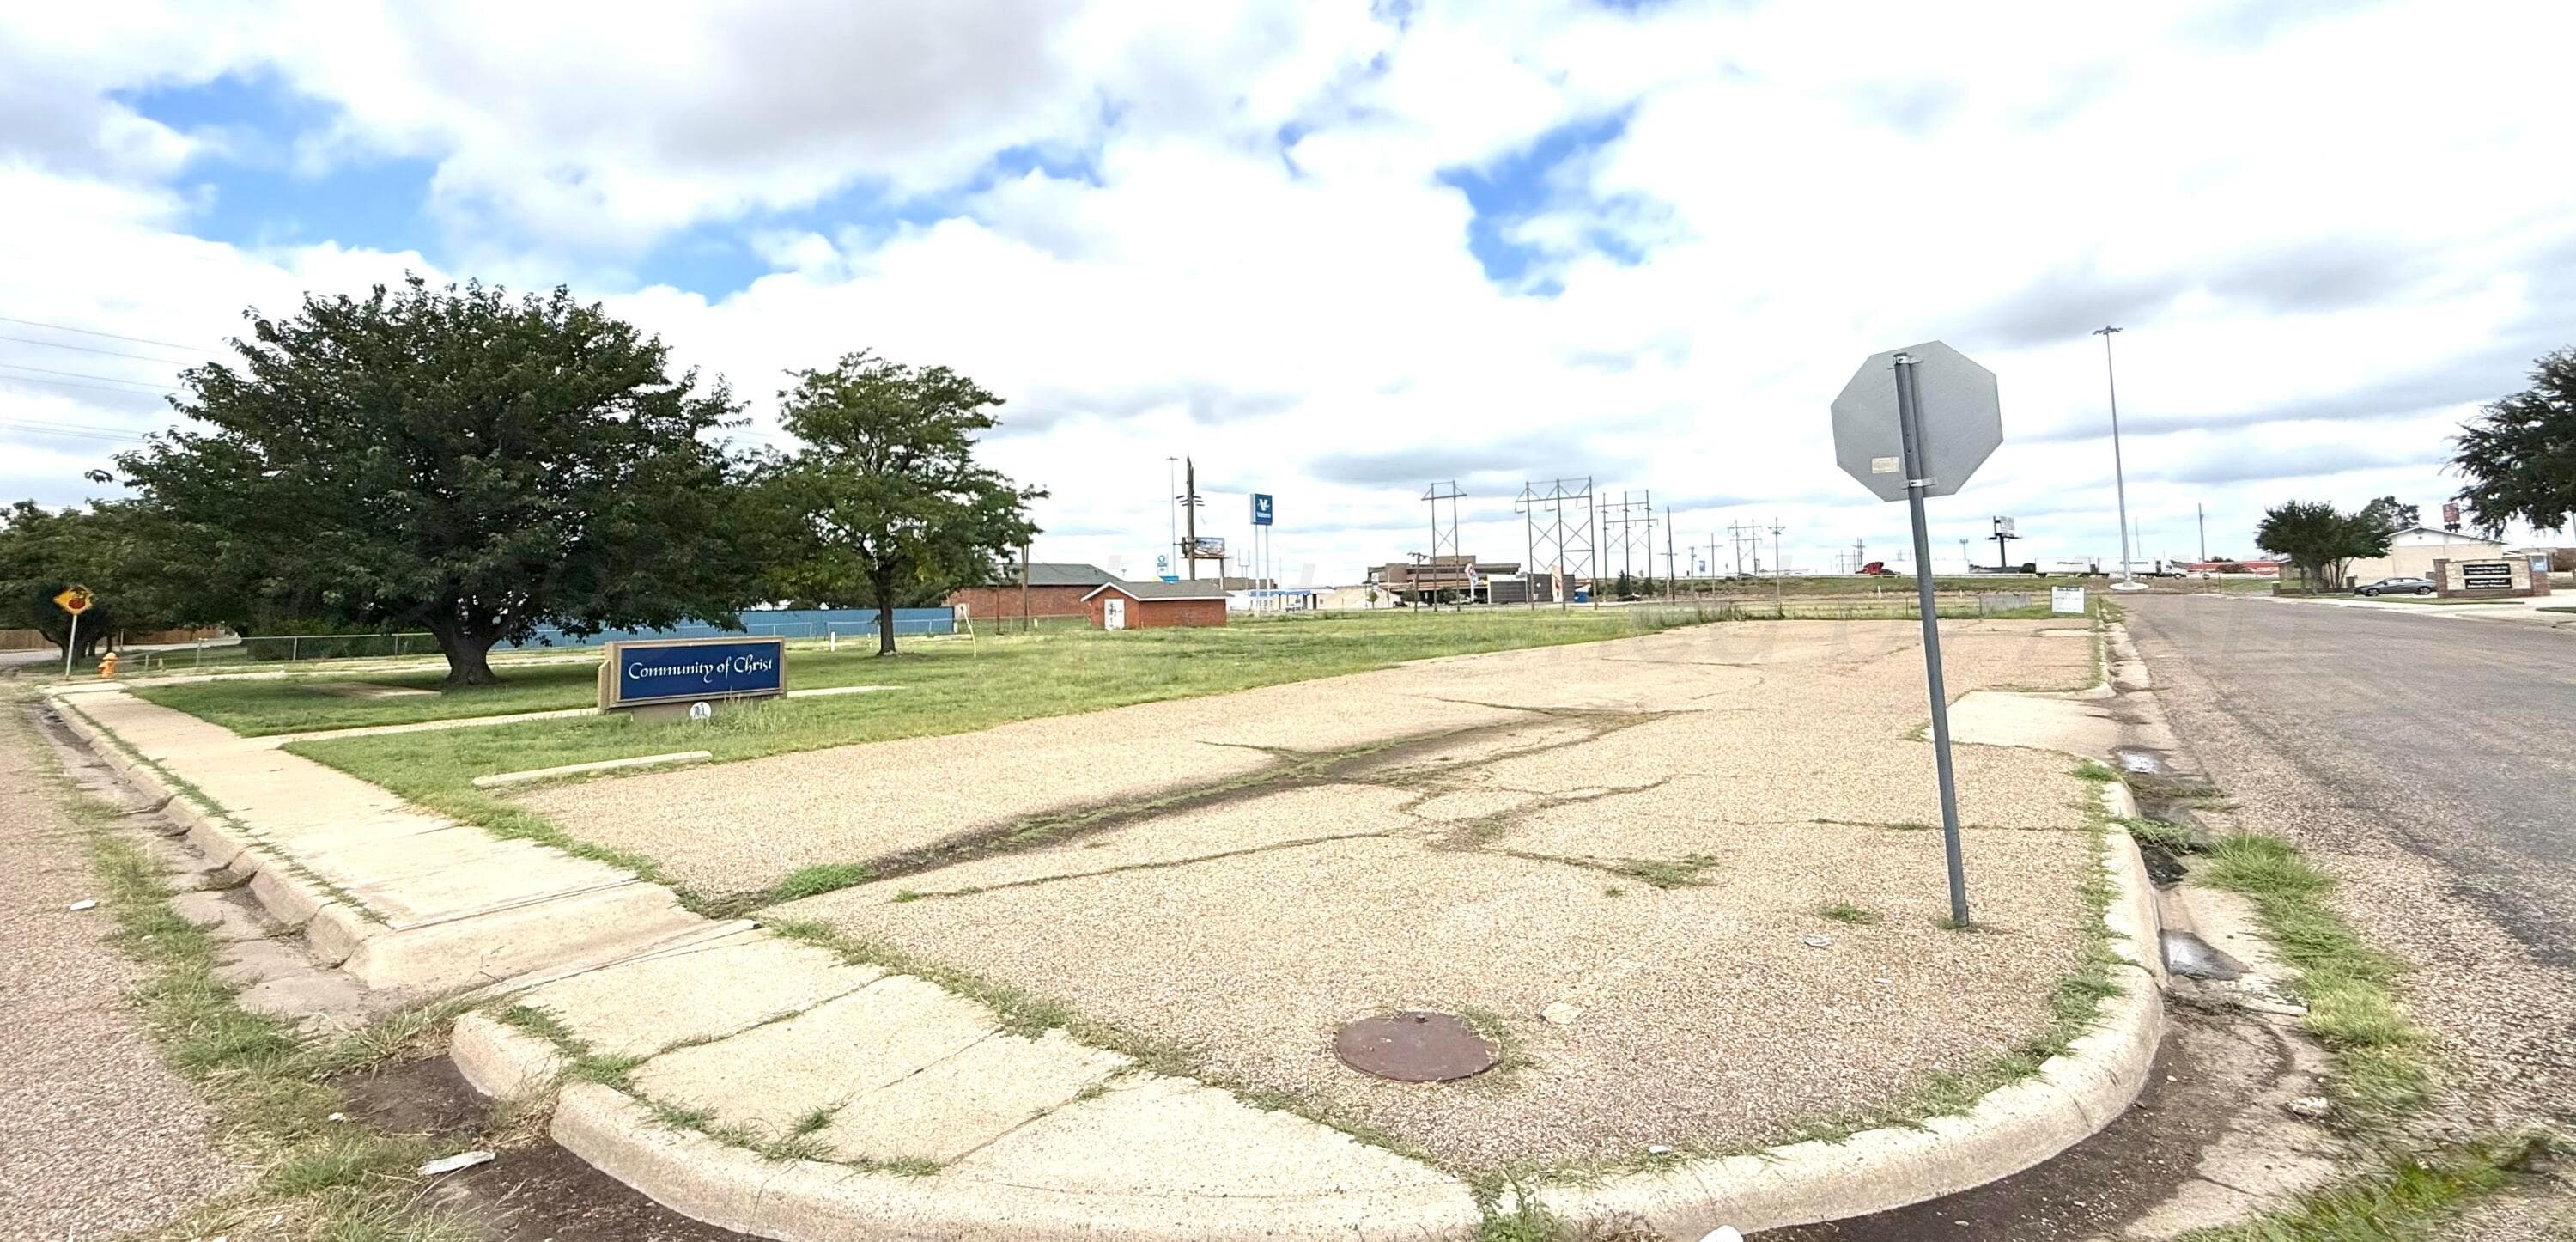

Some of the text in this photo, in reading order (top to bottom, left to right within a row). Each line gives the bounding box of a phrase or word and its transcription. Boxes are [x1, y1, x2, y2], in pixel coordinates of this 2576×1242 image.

[629, 654, 772, 684] Community of Christ
